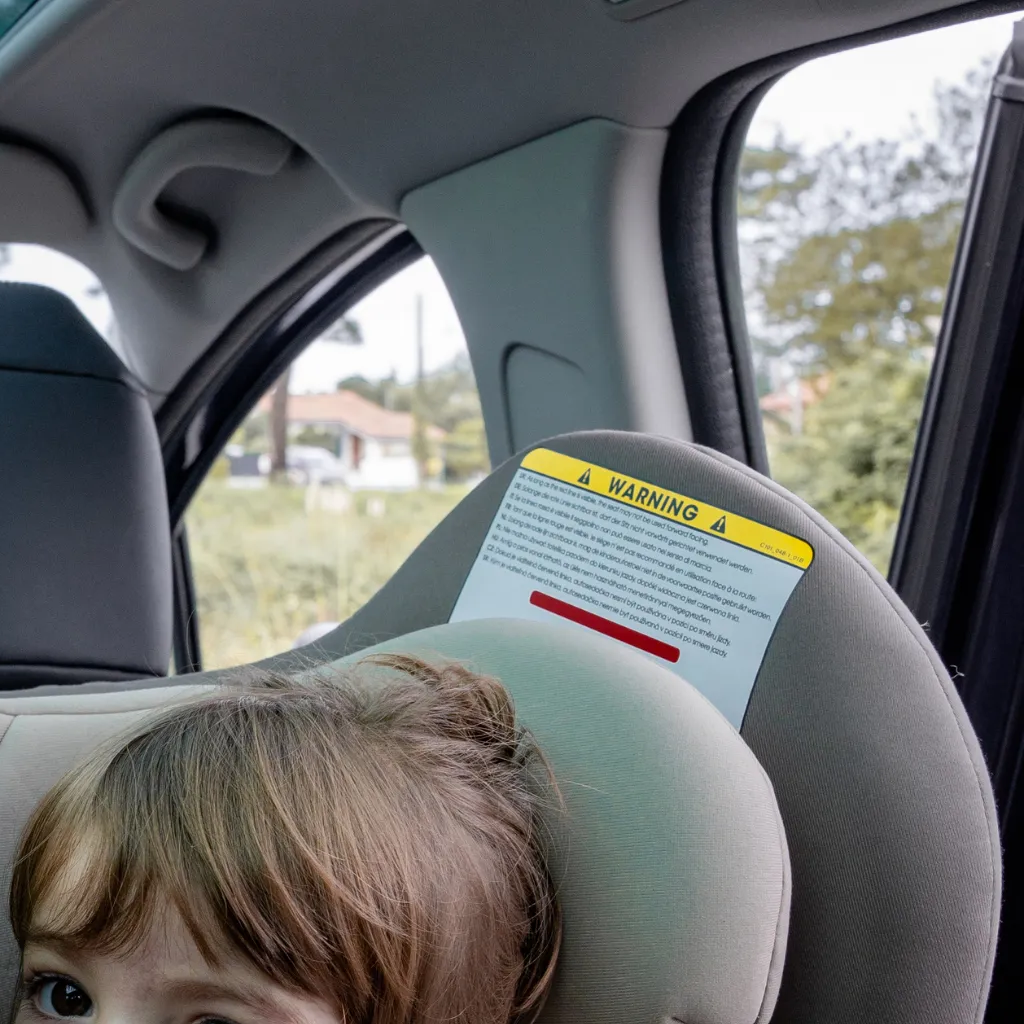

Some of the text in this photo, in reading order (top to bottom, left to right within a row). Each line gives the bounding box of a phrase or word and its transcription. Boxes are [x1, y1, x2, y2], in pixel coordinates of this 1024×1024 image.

[609, 477, 698, 520] WARNING
[599, 513, 612, 522] darf
[611, 518, 621, 526] der
[630, 526, 645, 534] nicht
[668, 540, 696, 553] gerichtet
[696, 550, 729, 565] verwendet
[607, 505, 620, 513] seat
[619, 510, 632, 518] may
[651, 521, 666, 529] used
[666, 525, 689, 538] forward
[578, 544, 591, 554] mag
[657, 573, 666, 581] de
[624, 549, 636, 557] pas
[712, 580, 727, 591] face
[640, 543, 657, 552] usato
[666, 552, 684, 562] senso
[697, 602, 727, 617] czerwona
[692, 640, 711, 651] smere
